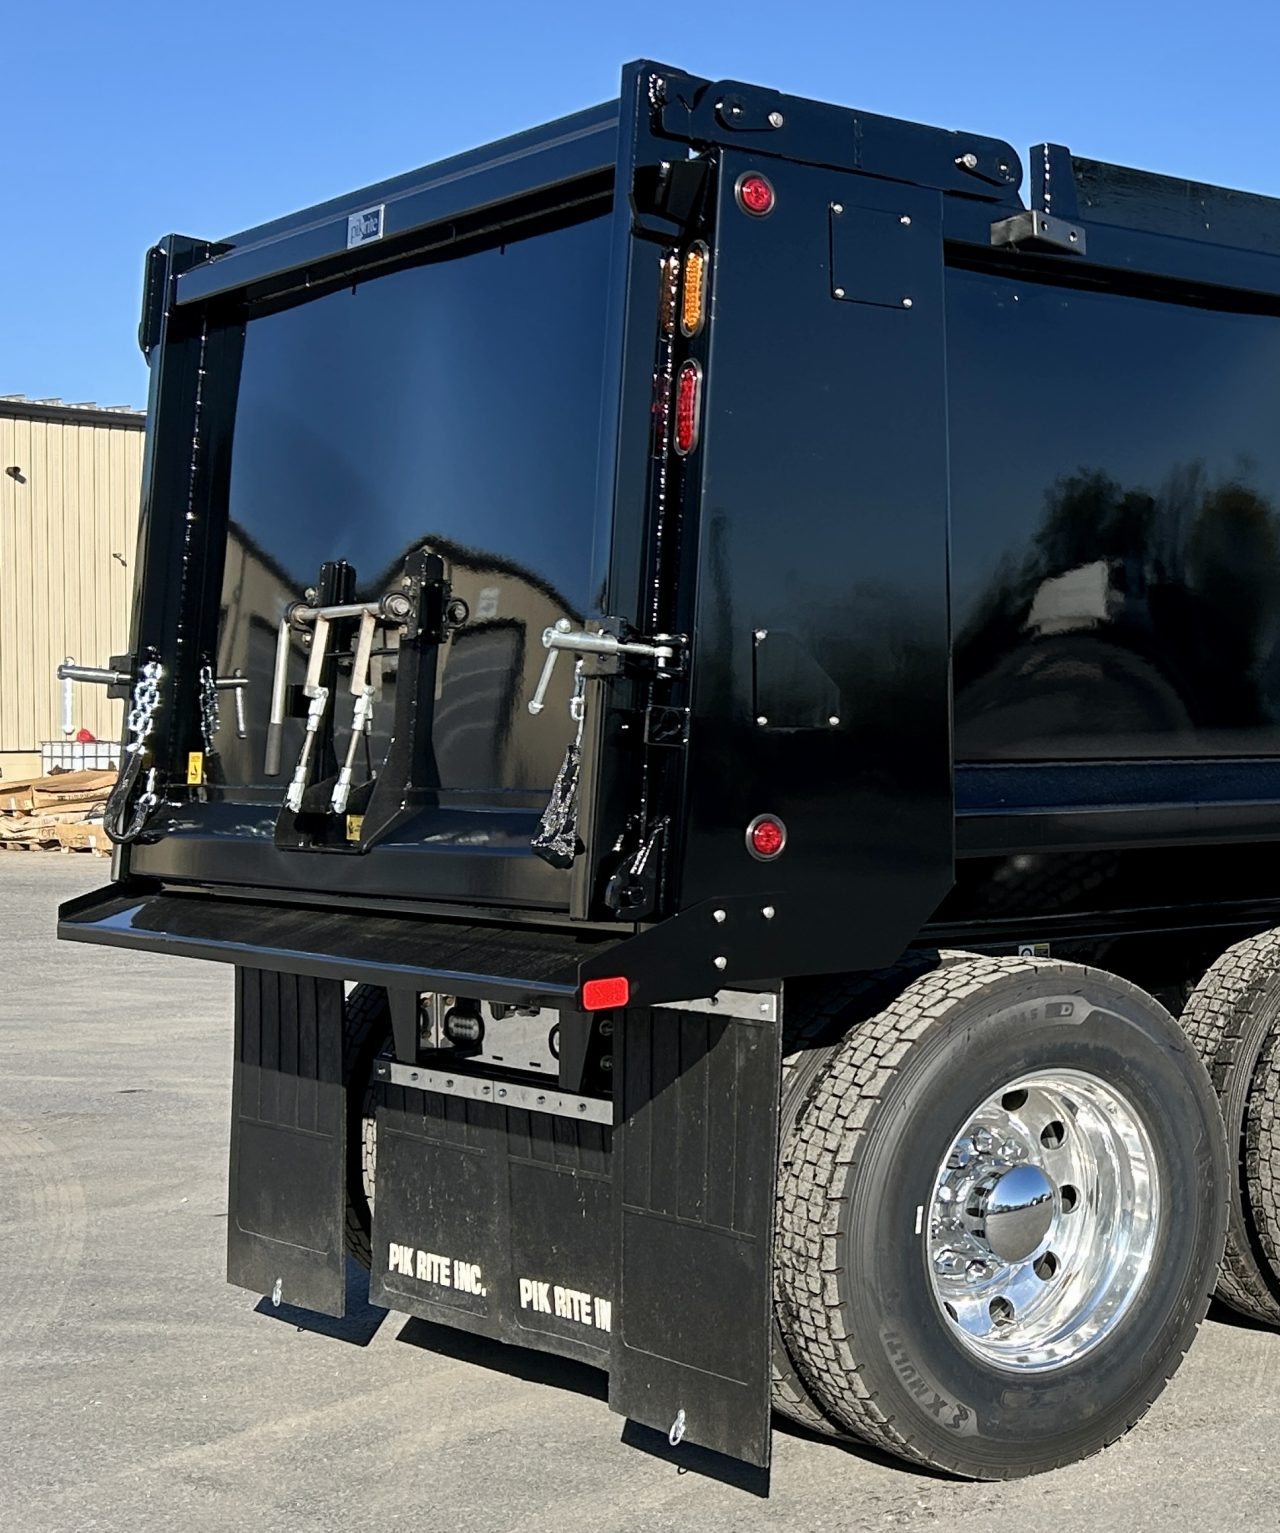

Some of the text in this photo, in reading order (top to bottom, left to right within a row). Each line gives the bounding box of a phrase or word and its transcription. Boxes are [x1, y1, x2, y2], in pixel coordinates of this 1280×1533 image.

[389, 1242, 487, 1297] PIK RITE INC.
[519, 1278, 552, 1314] PIK
[553, 1285, 592, 1325] RITE
[884, 1332, 930, 1398] MULTI
